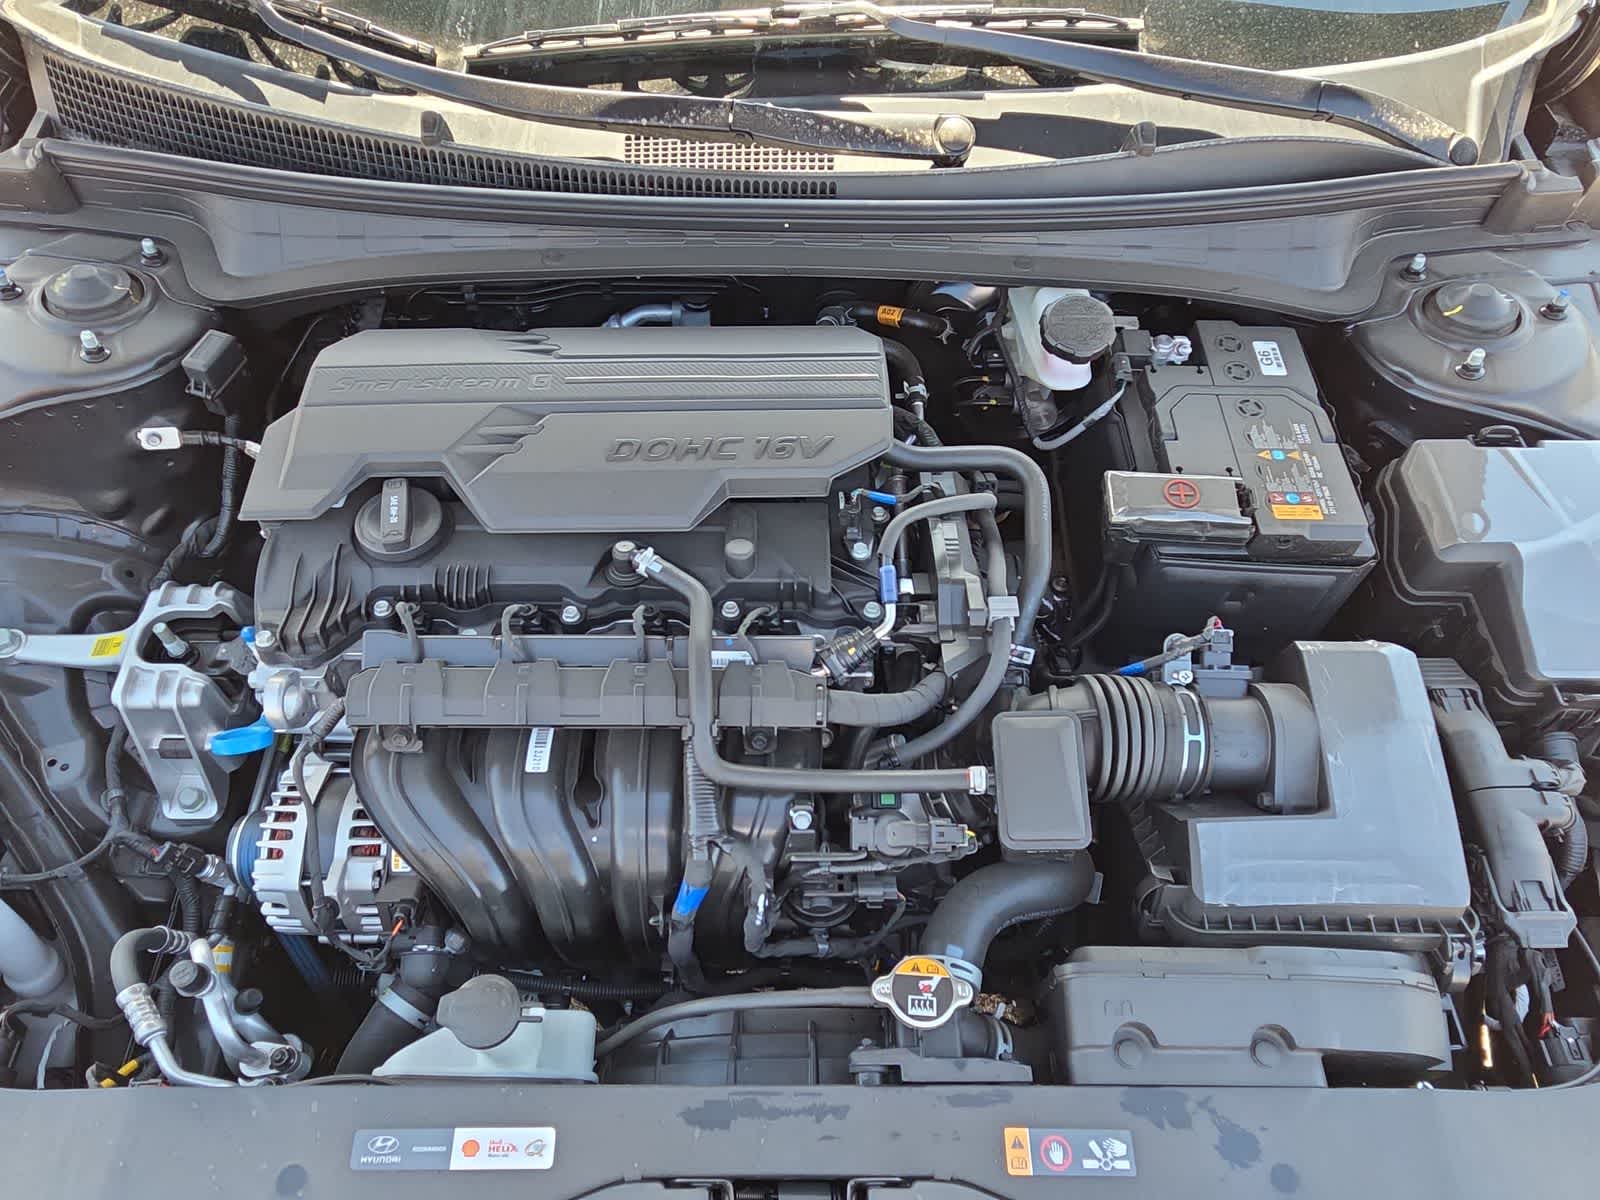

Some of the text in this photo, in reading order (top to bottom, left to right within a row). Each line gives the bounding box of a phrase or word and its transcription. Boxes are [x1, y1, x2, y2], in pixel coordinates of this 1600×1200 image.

[1258, 350, 1274, 367] G6
[329, 375, 521, 392] Smartstream
[606, 435, 835, 461] DOHC 16V
[360, 1155, 401, 1165] HYUNDAI
